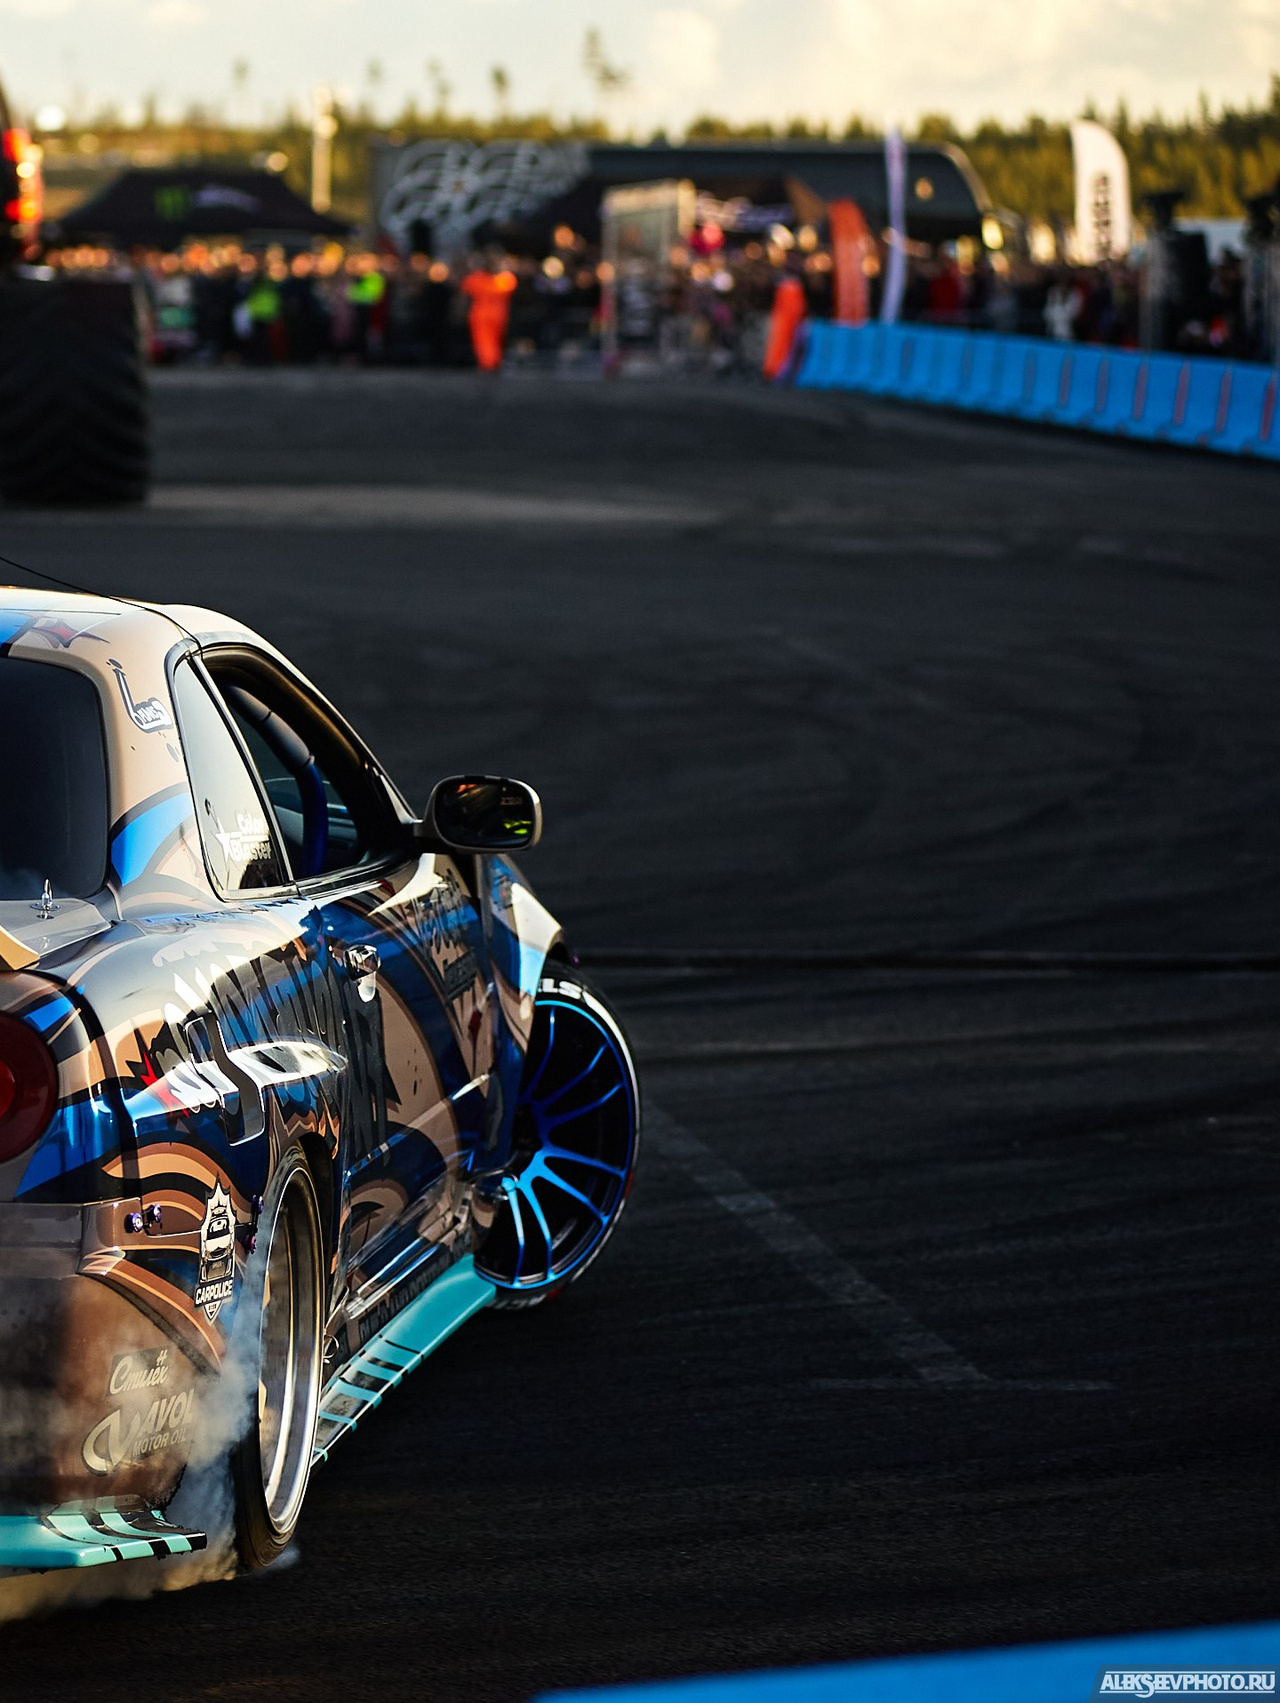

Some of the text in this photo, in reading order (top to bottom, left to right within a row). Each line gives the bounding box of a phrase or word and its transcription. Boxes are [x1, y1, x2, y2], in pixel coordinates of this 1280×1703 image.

[195, 1279, 234, 1305] CARPOLICE
[132, 1429, 188, 1457] MOTOR OIL
